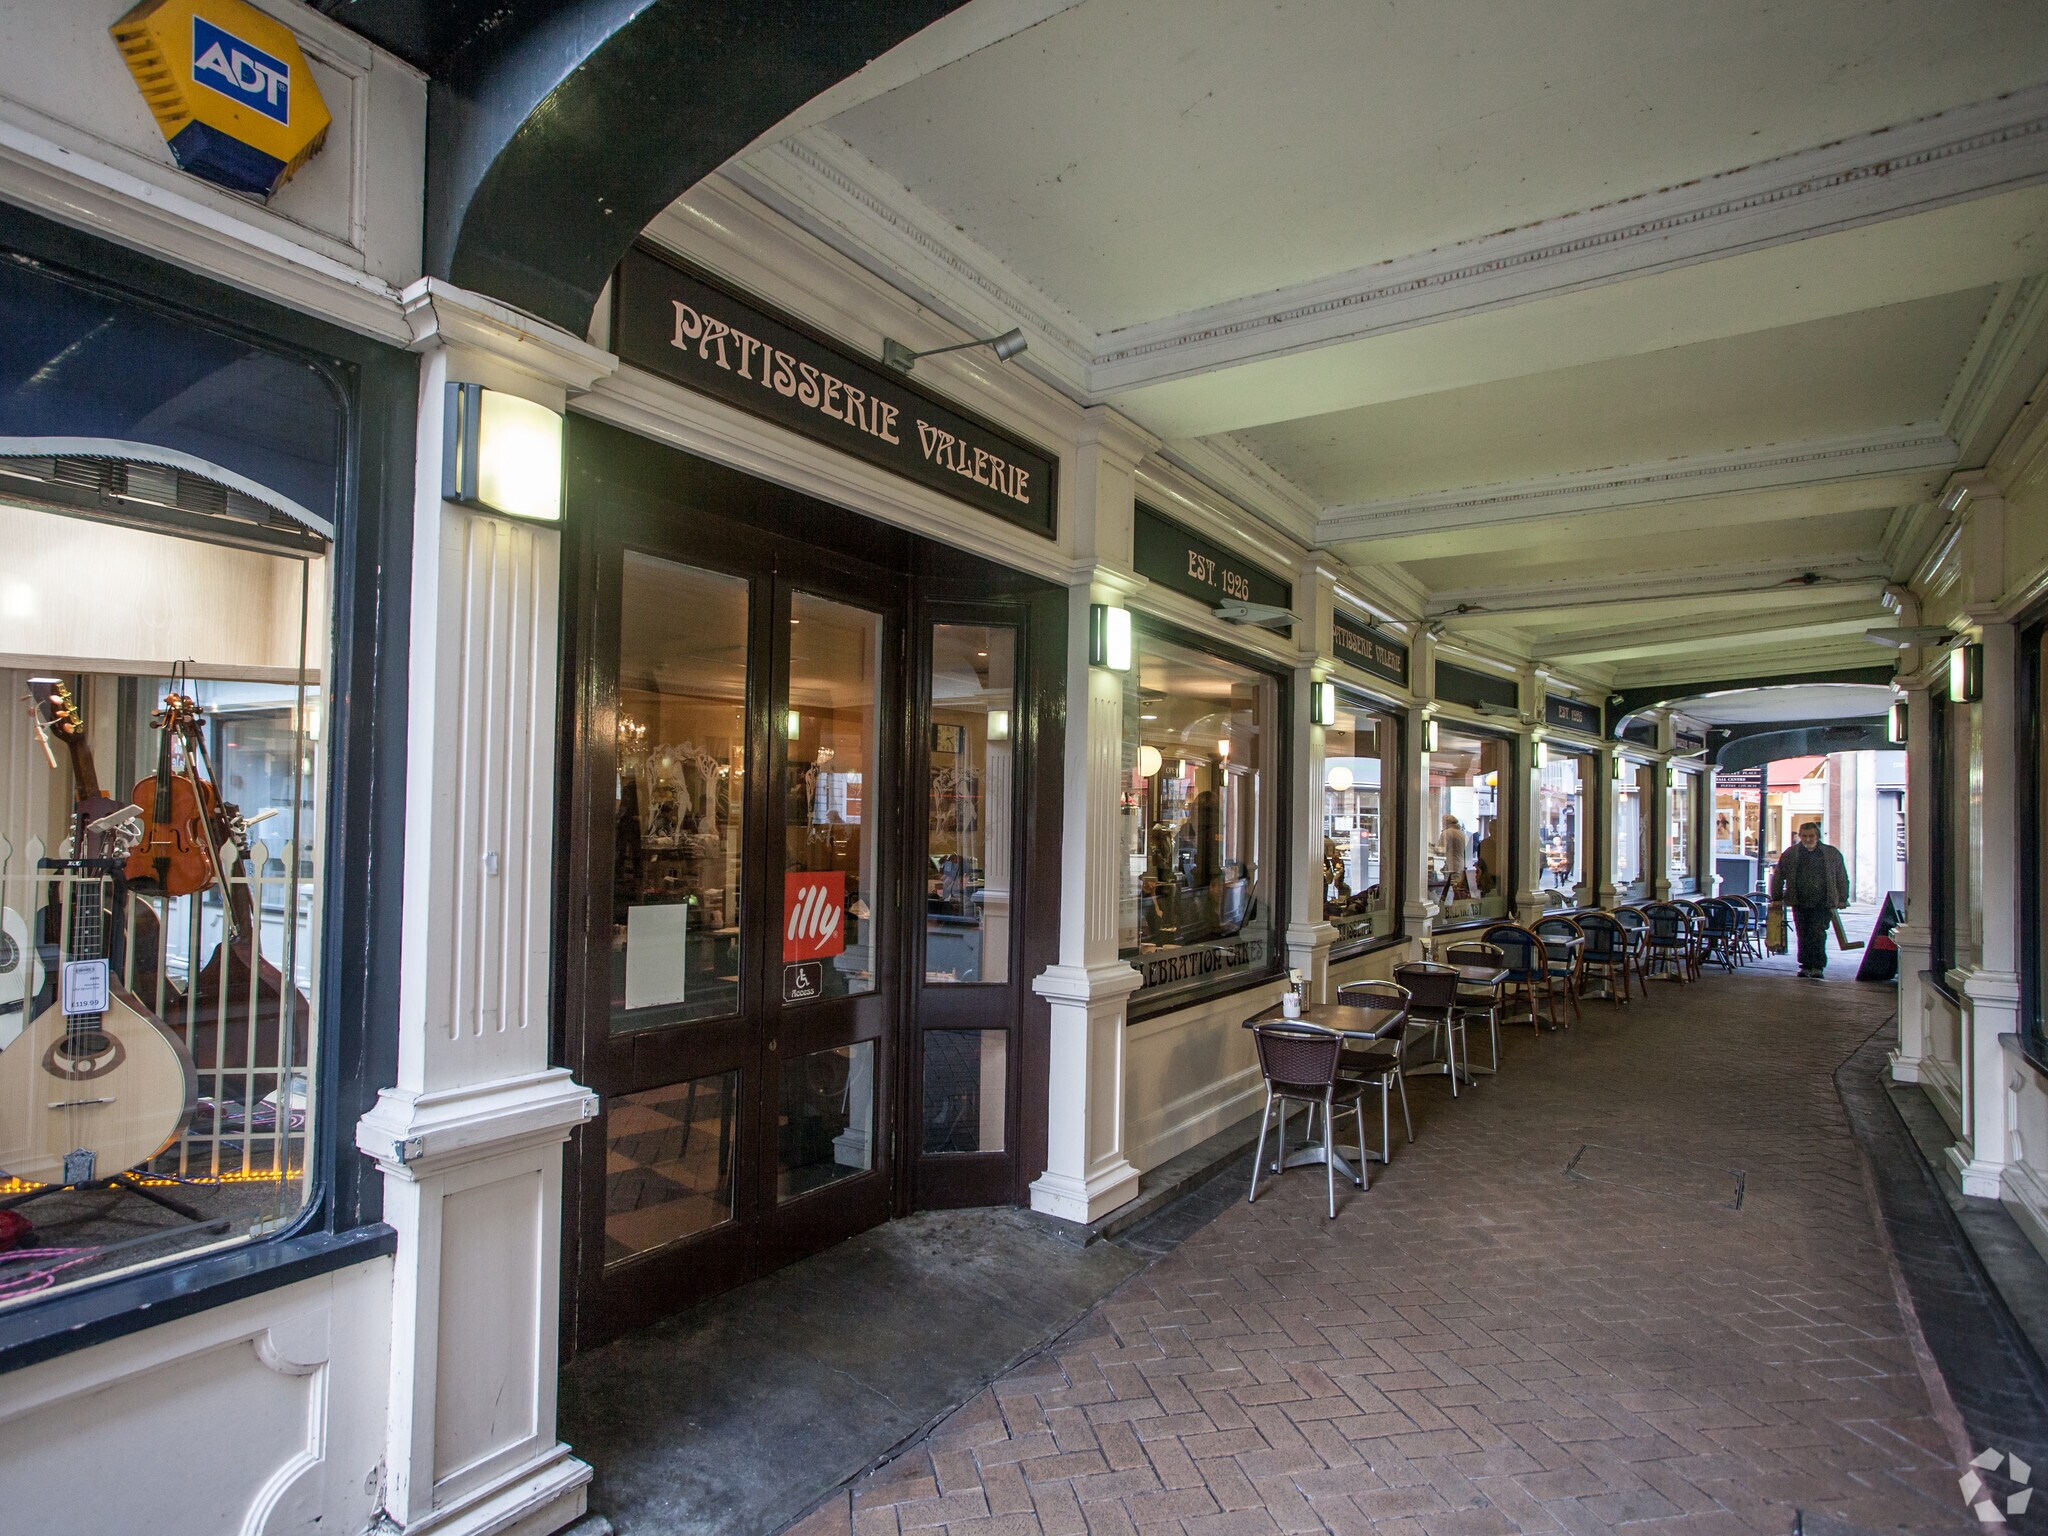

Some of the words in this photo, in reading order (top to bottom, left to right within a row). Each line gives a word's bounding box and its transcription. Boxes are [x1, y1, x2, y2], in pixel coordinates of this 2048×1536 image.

[194, 41, 287, 107] ADT
[669, 299, 900, 446] PATISSERIE
[916, 418, 1030, 505] VALERIE
[1187, 549, 1217, 588] EST.
[1221, 568, 1250, 602] 1926
[788, 884, 842, 951] illy
[1226, 939, 1264, 968] CAKES
[791, 987, 815, 998] Access
